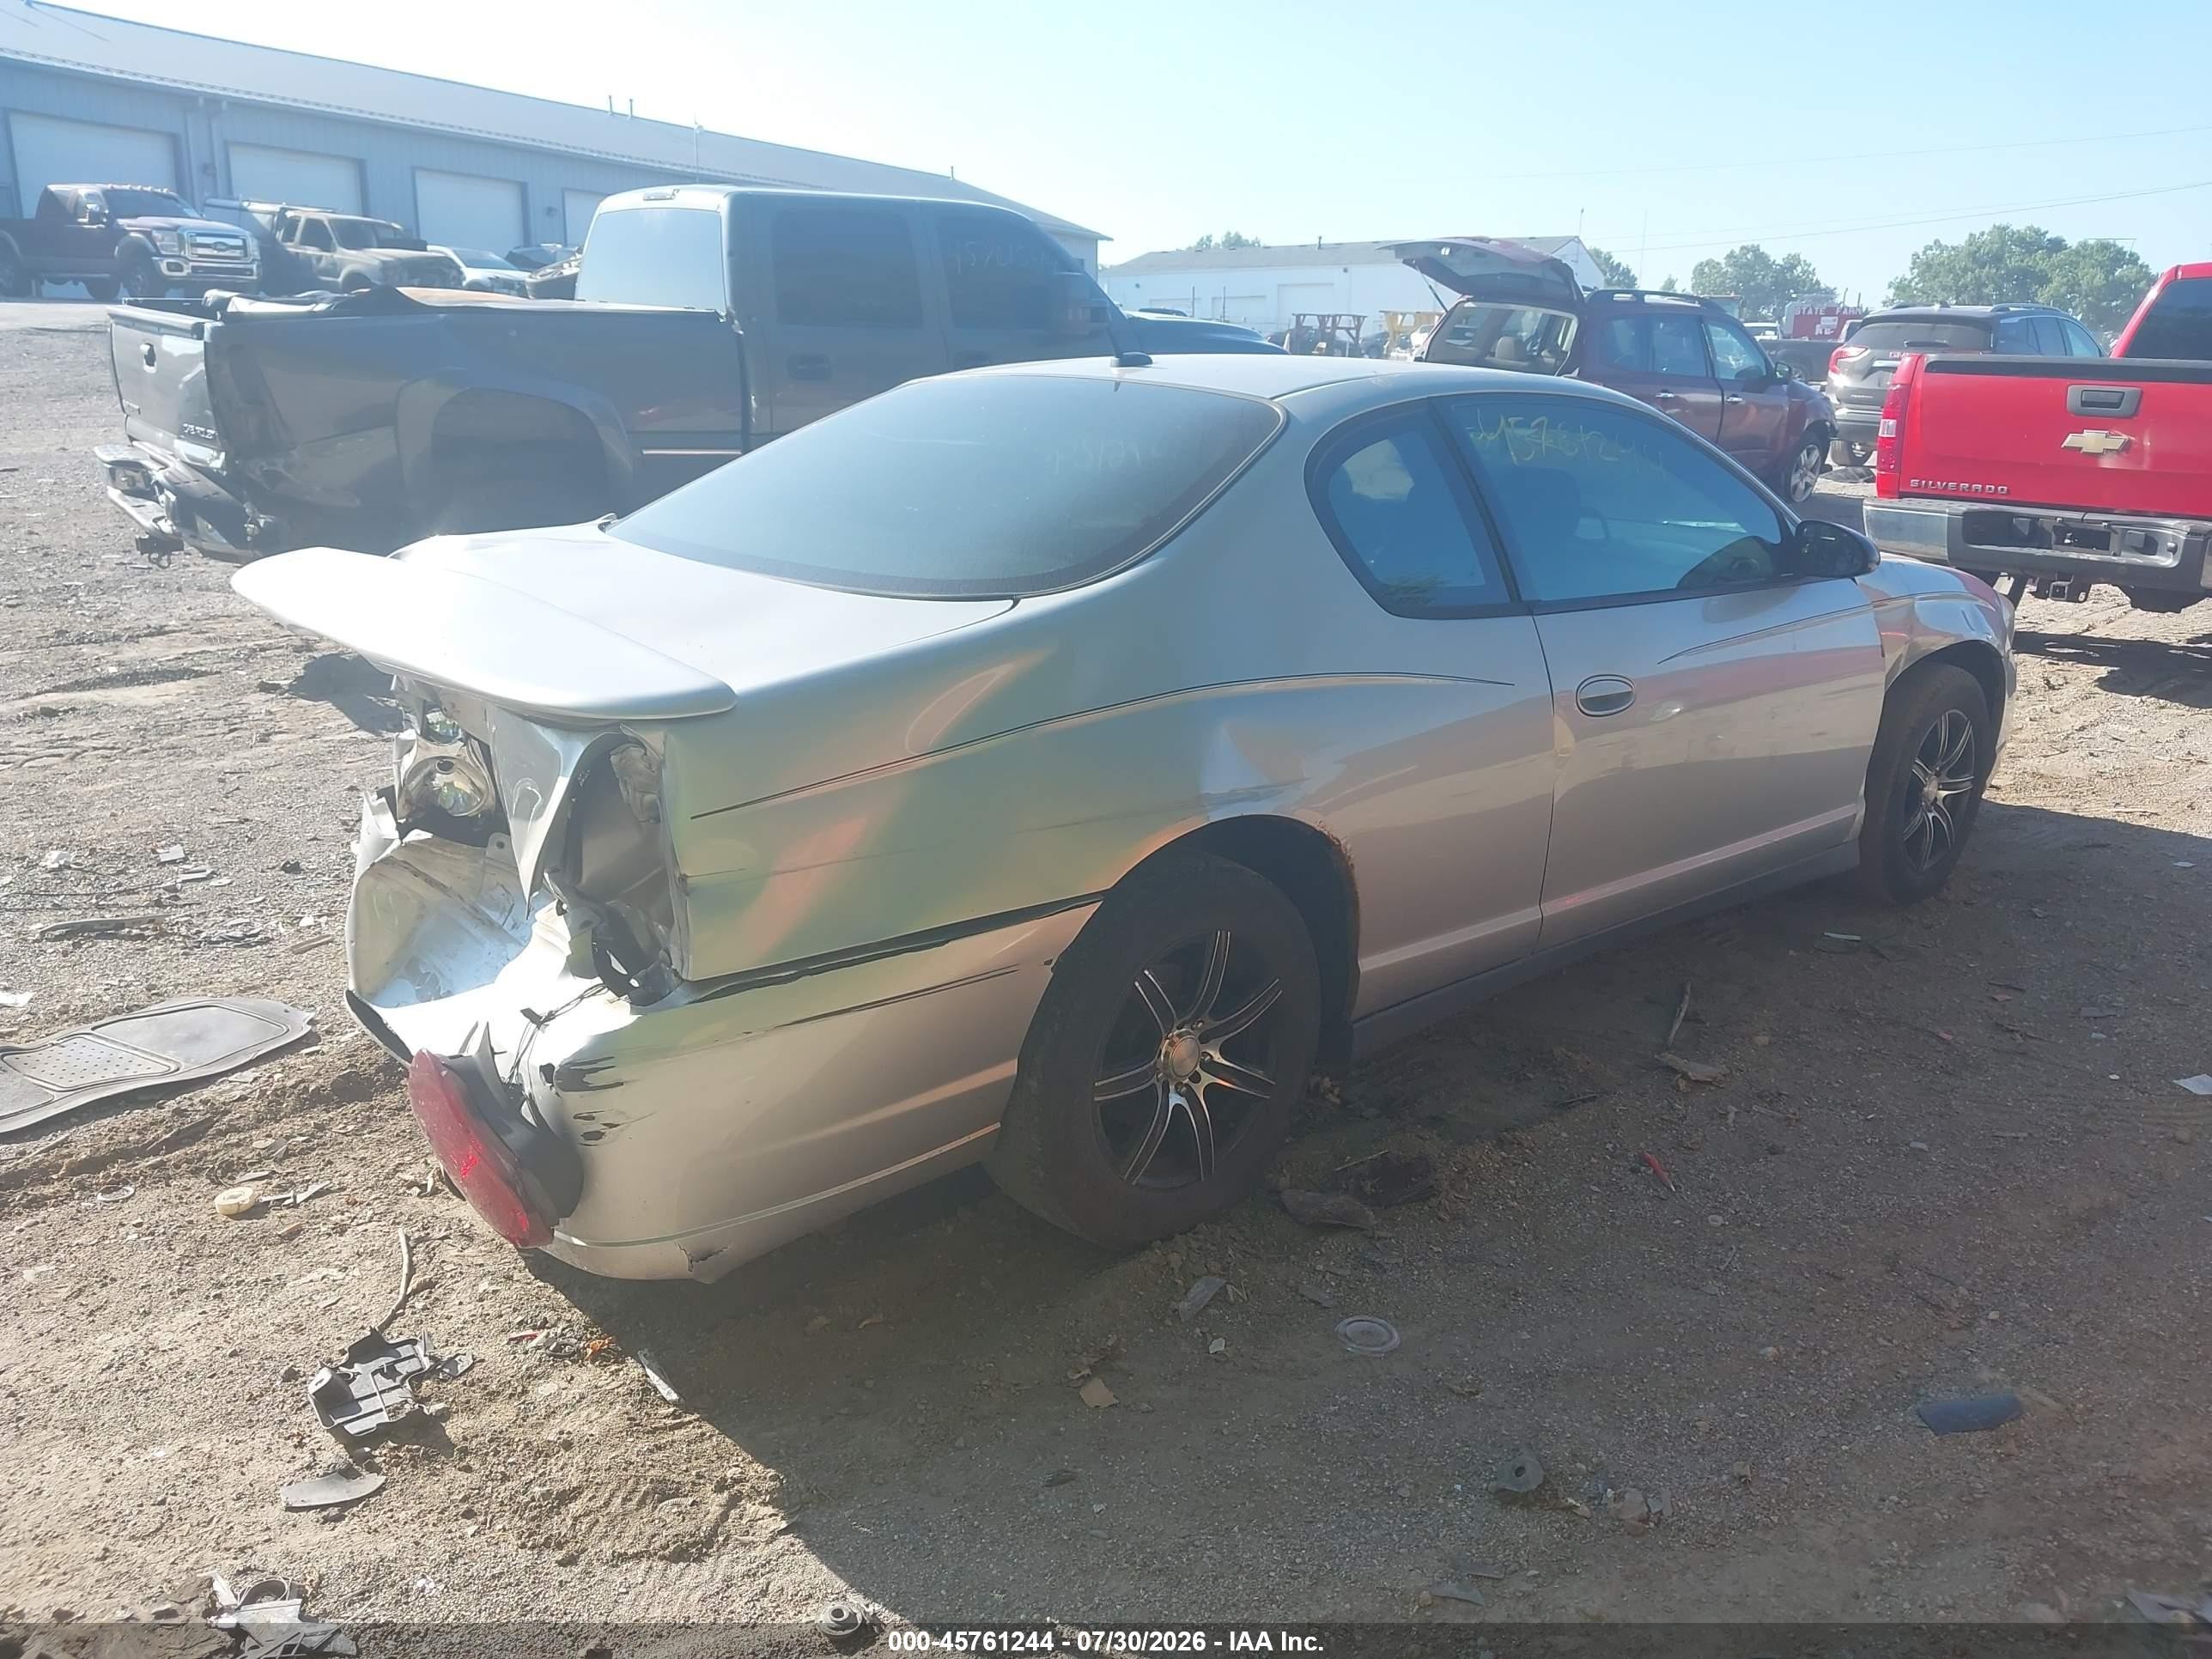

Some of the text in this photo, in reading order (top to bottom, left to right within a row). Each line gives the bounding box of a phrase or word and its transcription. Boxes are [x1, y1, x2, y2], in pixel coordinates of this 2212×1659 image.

[1794, 307, 1863, 316] STATE FARM
[1909, 478, 2009, 495] SILVERADO
